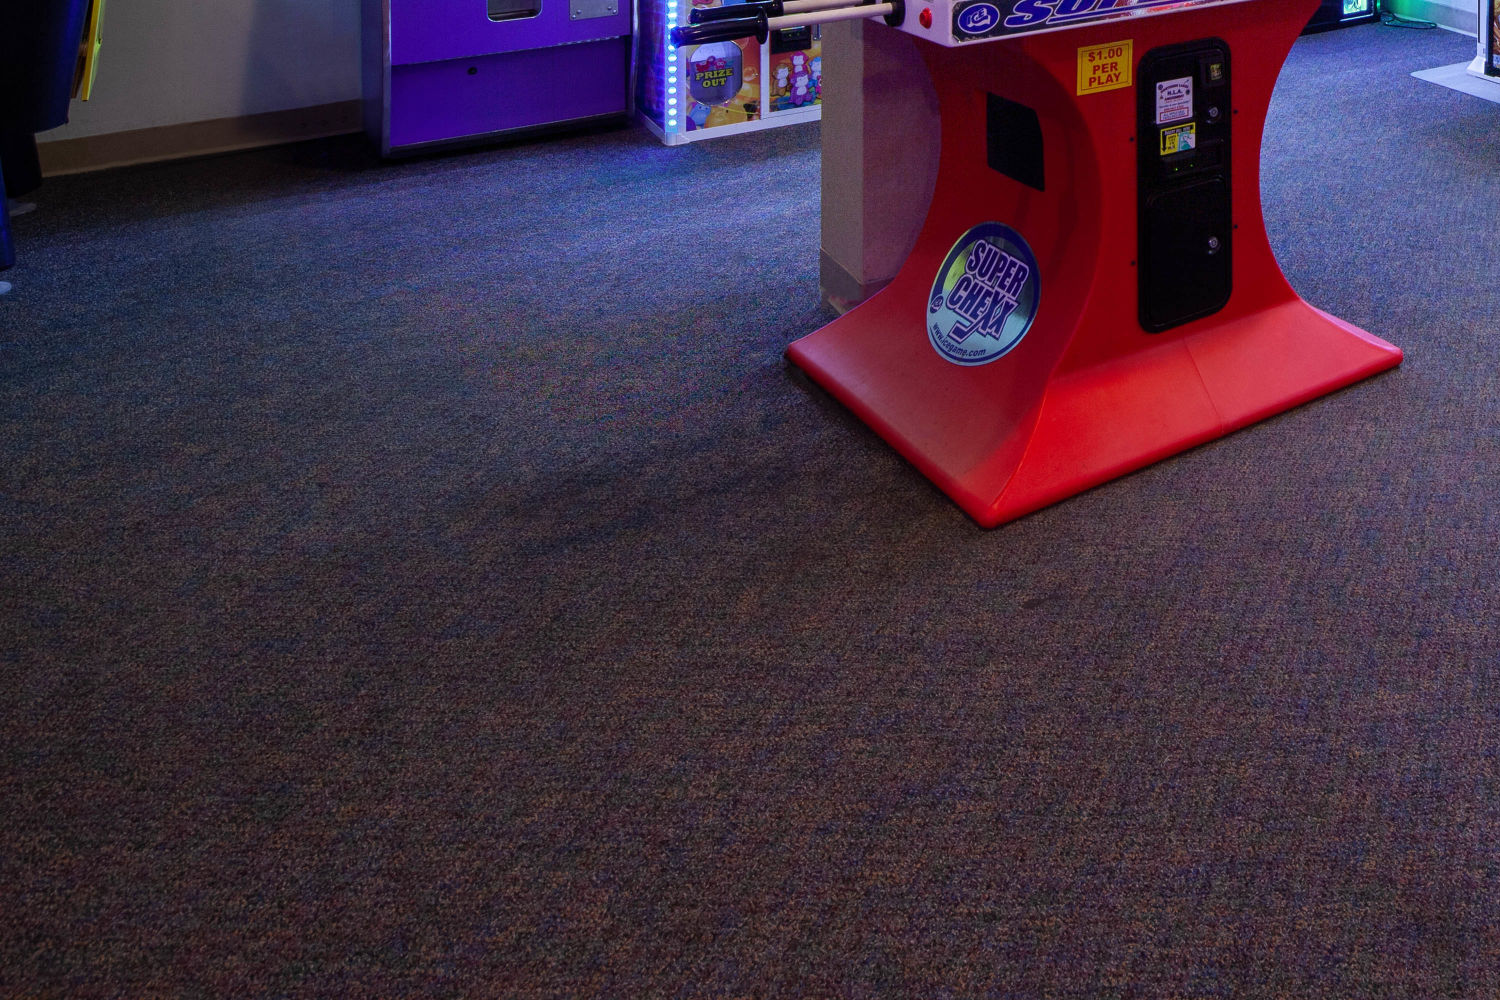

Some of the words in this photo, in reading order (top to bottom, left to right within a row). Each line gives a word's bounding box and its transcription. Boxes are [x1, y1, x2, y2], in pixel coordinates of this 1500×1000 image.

[1088, 47, 1123, 63] $1.00
[695, 68, 734, 81] PRIZE
[1092, 62, 1118, 75] PER
[702, 77, 727, 88] OUT
[1088, 73, 1121, 87] PLAY
[965, 239, 1030, 300] SUPER
[945, 274, 1020, 341] CHEXX
